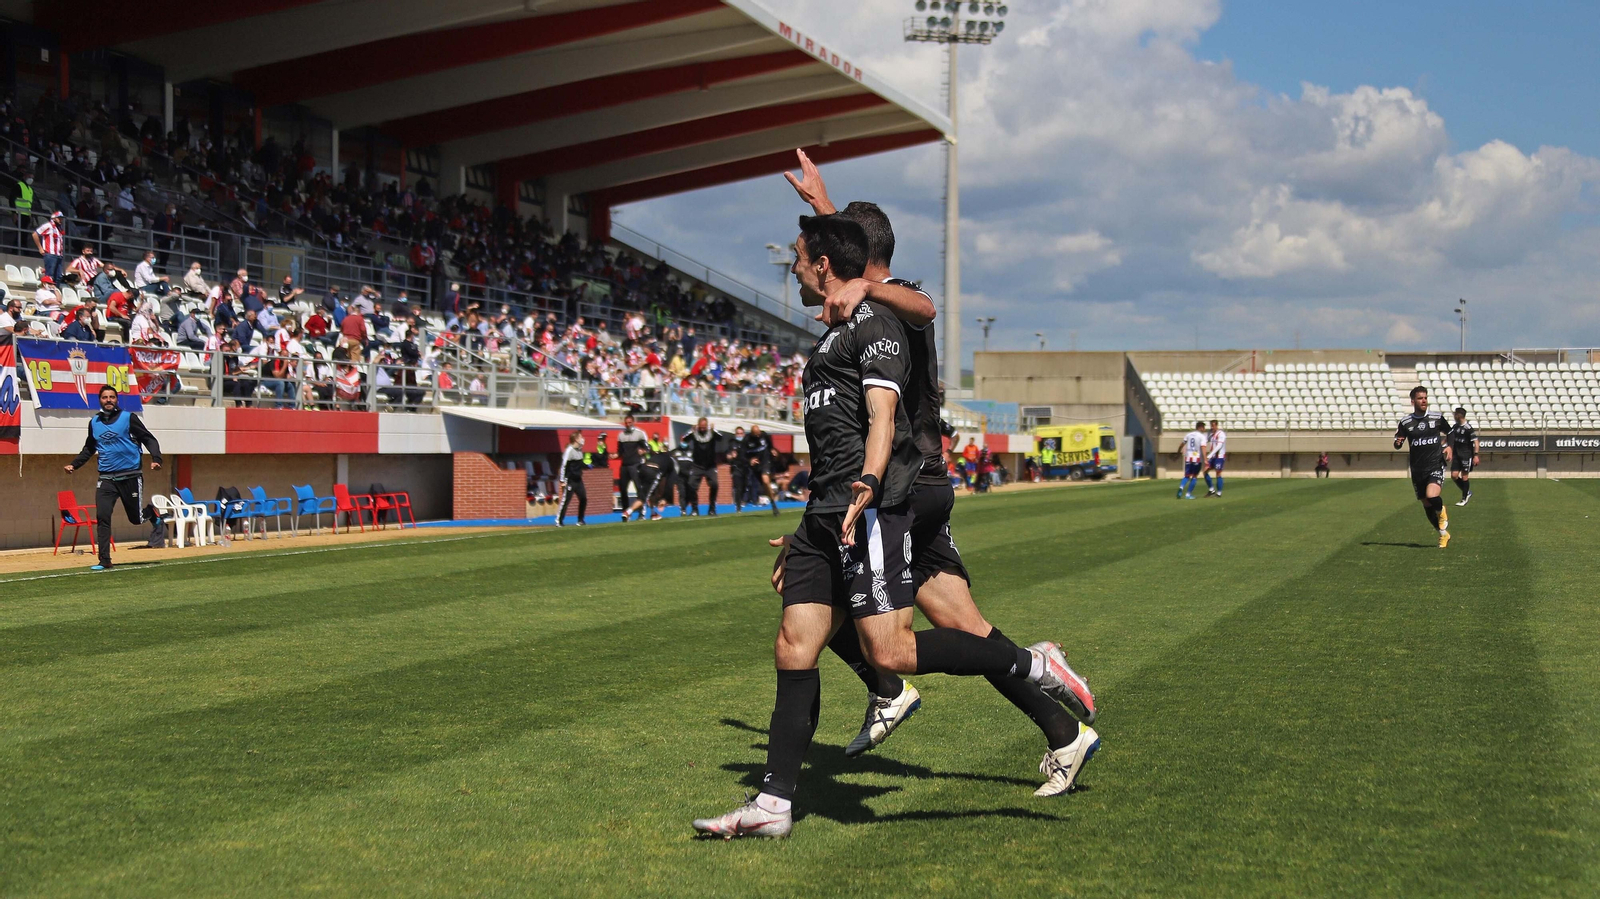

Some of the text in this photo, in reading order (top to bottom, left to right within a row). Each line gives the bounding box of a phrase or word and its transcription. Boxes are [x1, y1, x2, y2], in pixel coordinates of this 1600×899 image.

[779, 21, 862, 82] MIRADOR
[28, 360, 53, 391] 19
[1189, 437, 1196, 448] 8
[1473, 440, 1493, 448] ora
[1495, 439, 1506, 448] de
[1508, 440, 1540, 448] marcas
[1057, 450, 1091, 465] SERVIS
